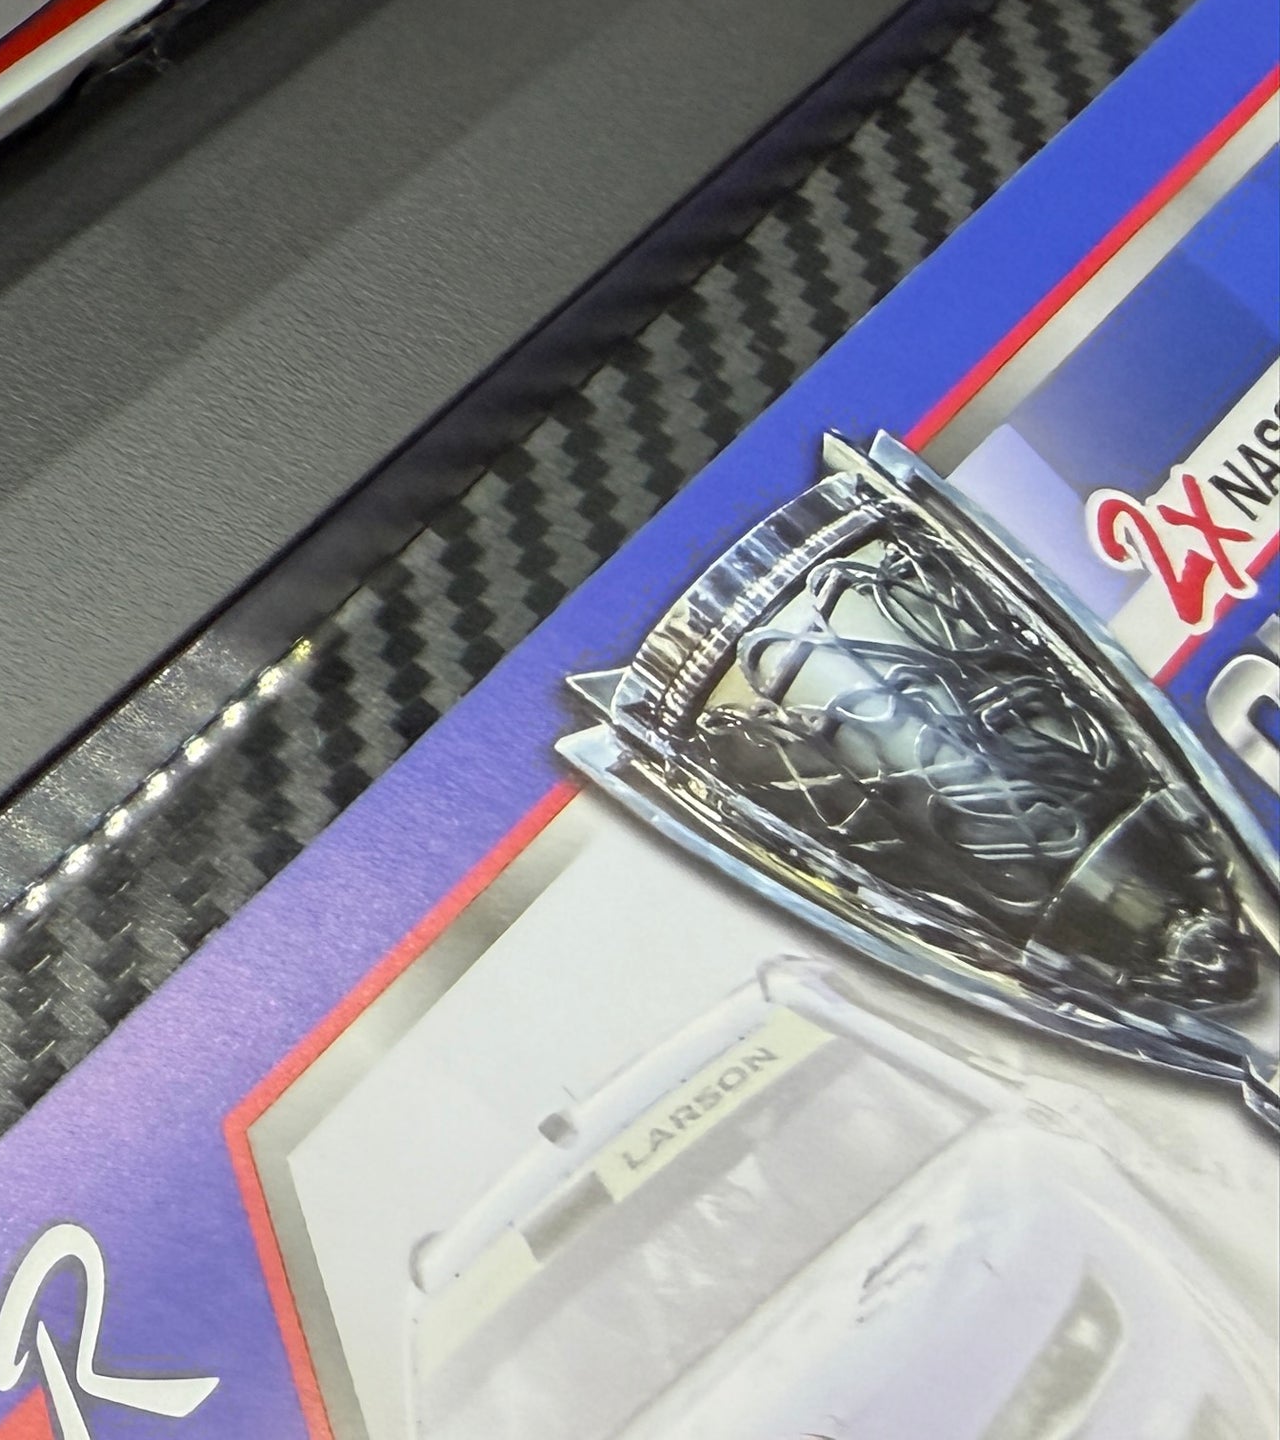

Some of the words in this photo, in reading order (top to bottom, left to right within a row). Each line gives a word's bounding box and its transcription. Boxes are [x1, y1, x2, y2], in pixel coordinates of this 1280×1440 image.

[1096, 473, 1256, 625] 2X
[1207, 400, 1280, 521] NAS
[619, 1045, 780, 1173] LARSON
